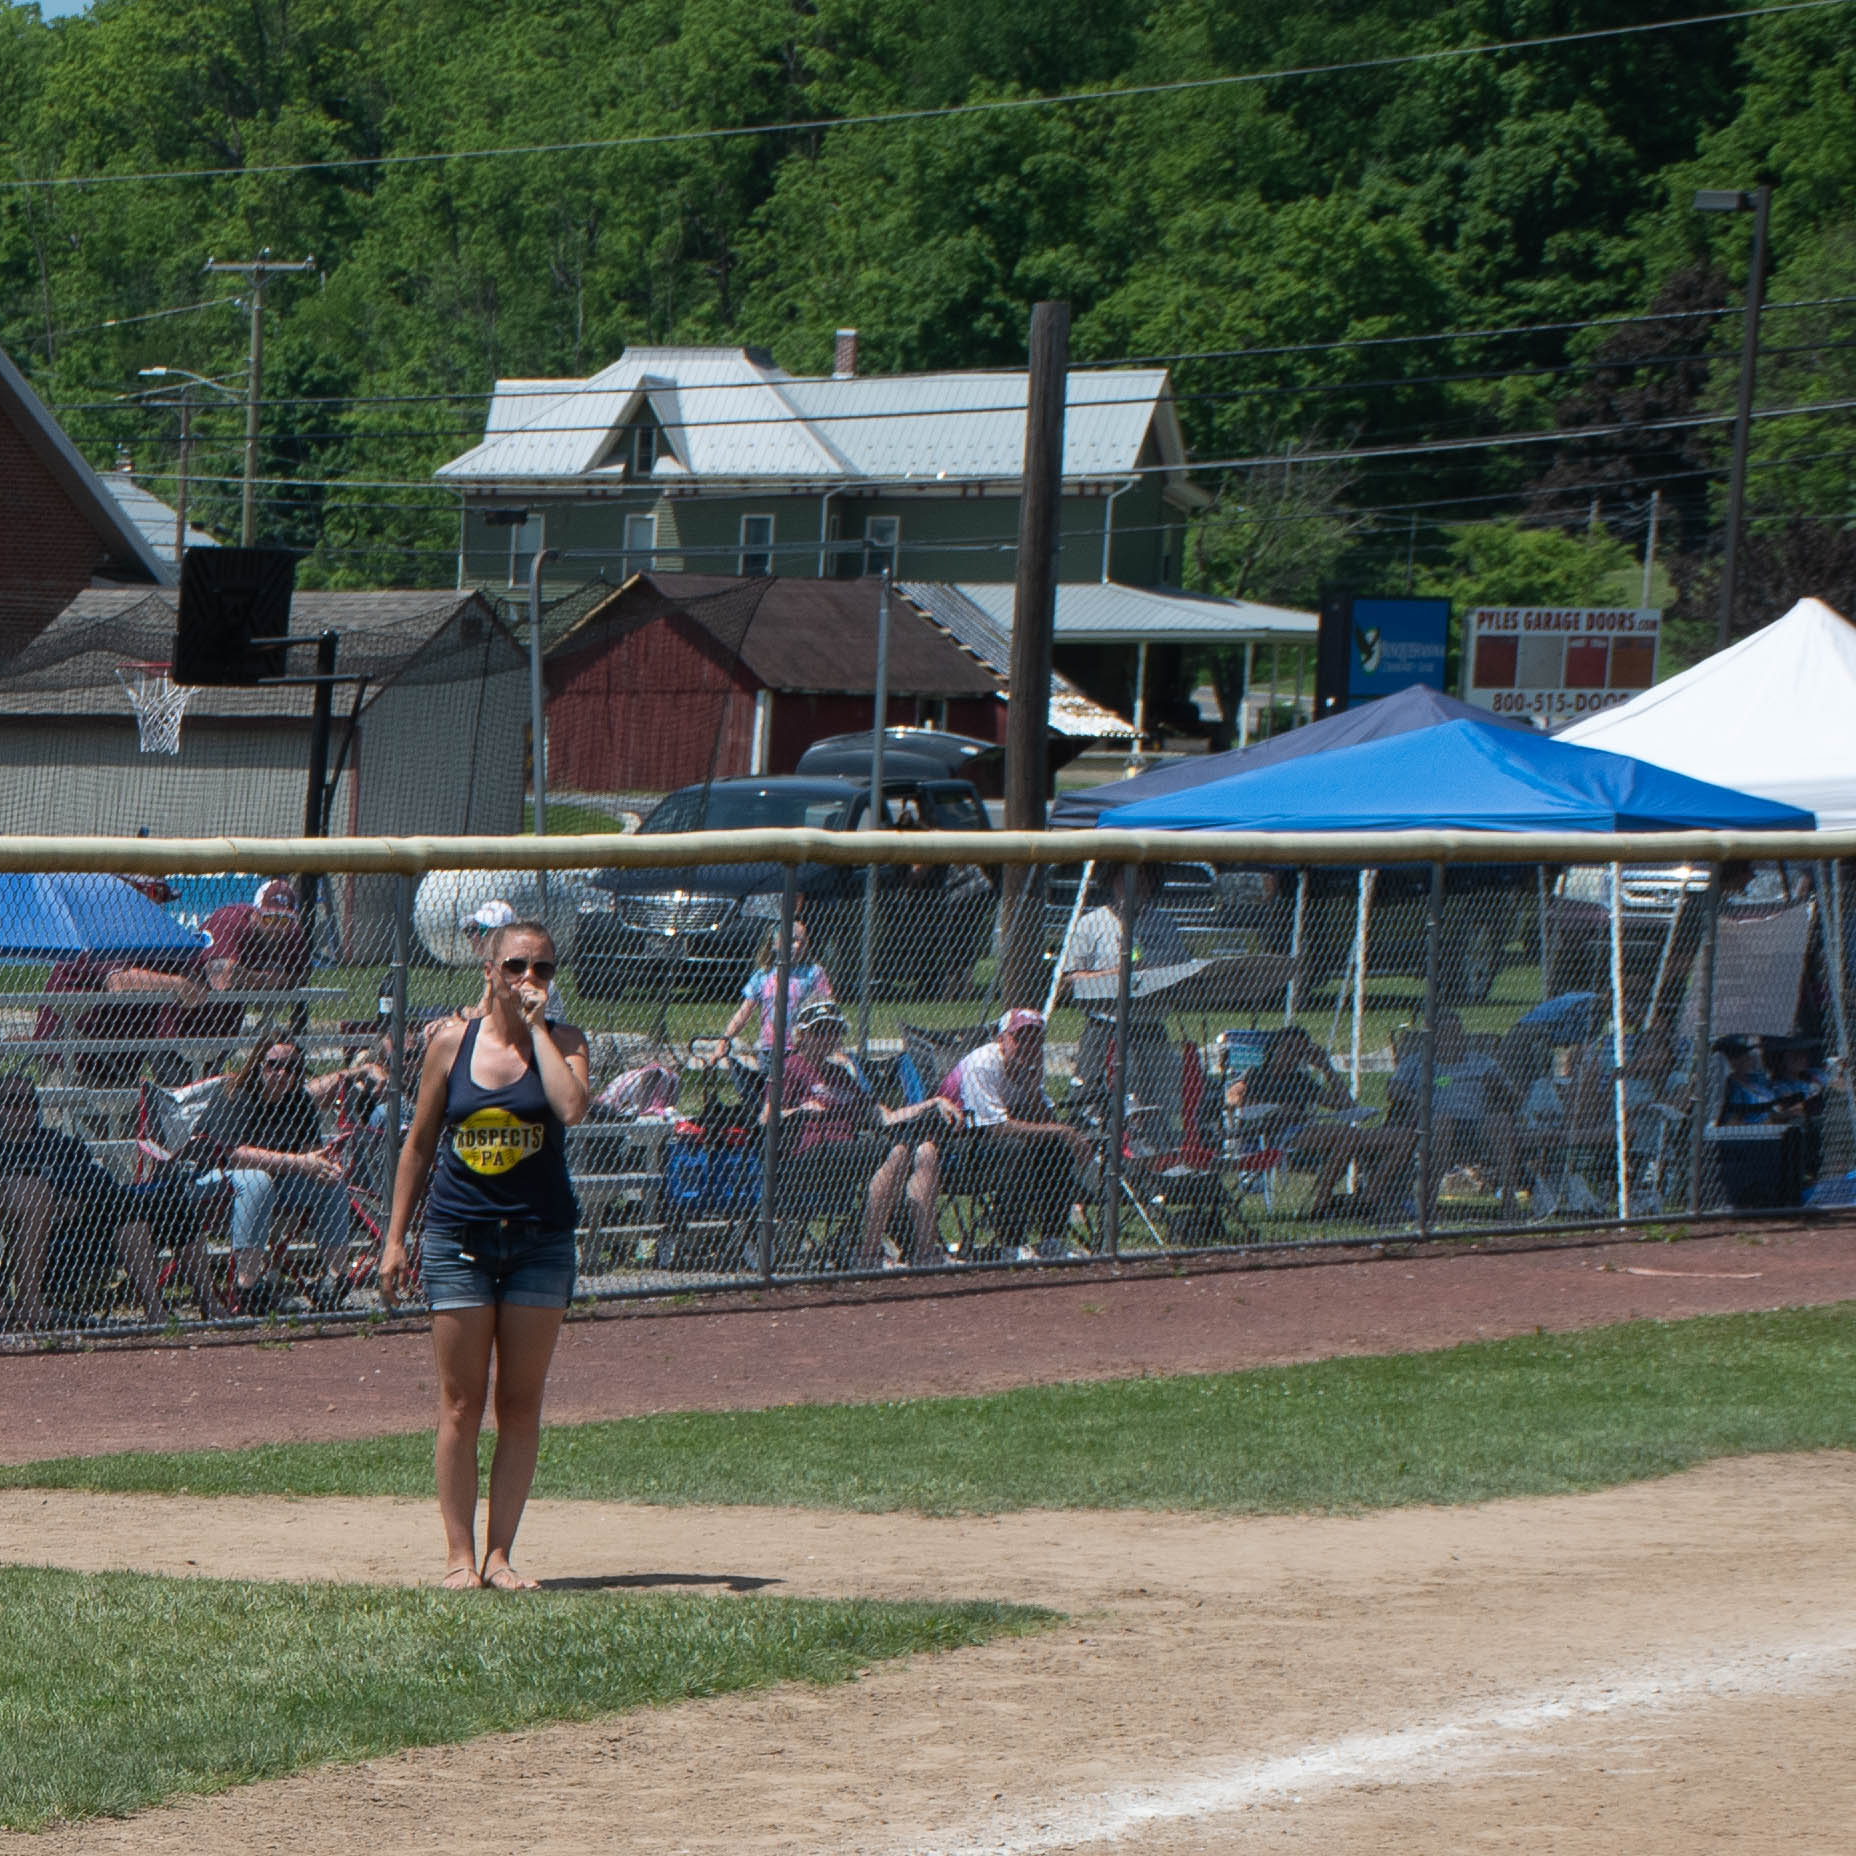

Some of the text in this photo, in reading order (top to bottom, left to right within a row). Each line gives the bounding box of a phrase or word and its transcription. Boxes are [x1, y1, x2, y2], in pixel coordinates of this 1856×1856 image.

[1476, 611, 1519, 631] PYLES
[1523, 611, 1581, 631] GARAGE
[453, 1123, 544, 1149] ROSPECTS
[480, 1151, 504, 1167] PA
